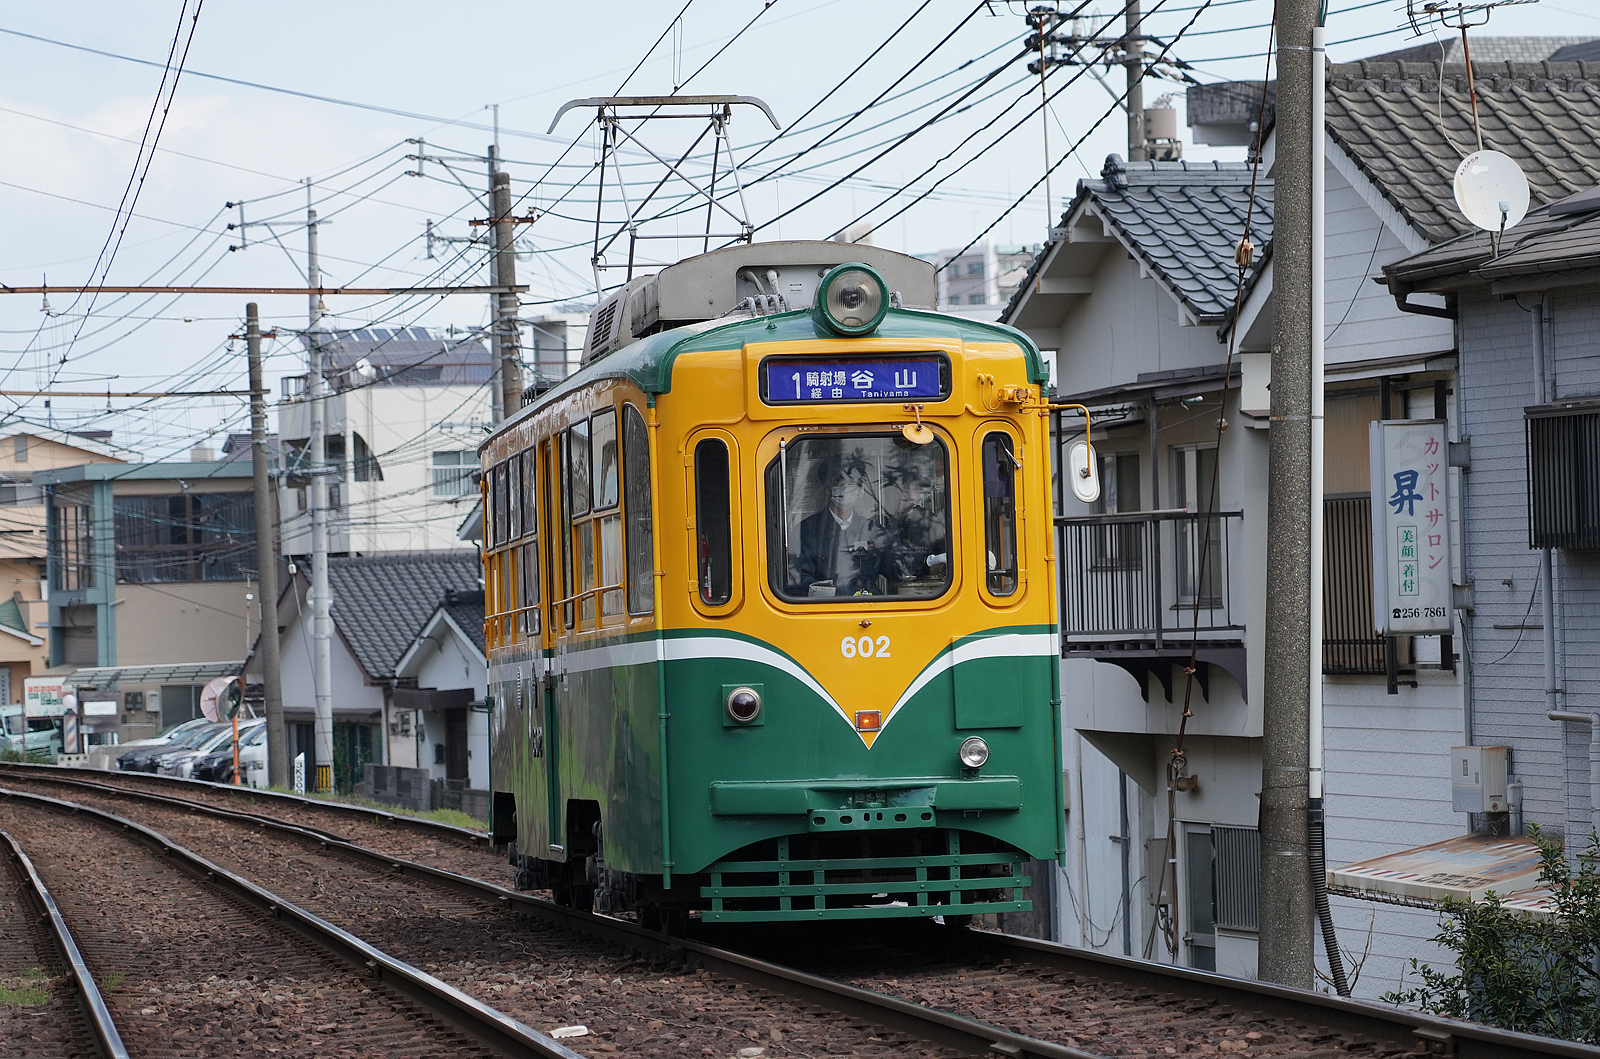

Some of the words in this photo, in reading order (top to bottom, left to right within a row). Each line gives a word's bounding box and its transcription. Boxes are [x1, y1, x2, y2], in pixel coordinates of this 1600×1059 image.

[792, 372, 800, 399] 1
[806, 371, 846, 386] 騎射場
[851, 369, 917, 389] 谷山
[811, 388, 843, 399] 経由
[861, 390, 909, 398] Taniyama
[1388, 469, 1424, 517] 昇
[1424, 437, 1444, 570] カットサロン
[1401, 530, 1414, 558] 美顔
[1402, 564, 1415, 593] 着付
[1402, 607, 1446, 618] 256-7861
[841, 635, 891, 658] 602
